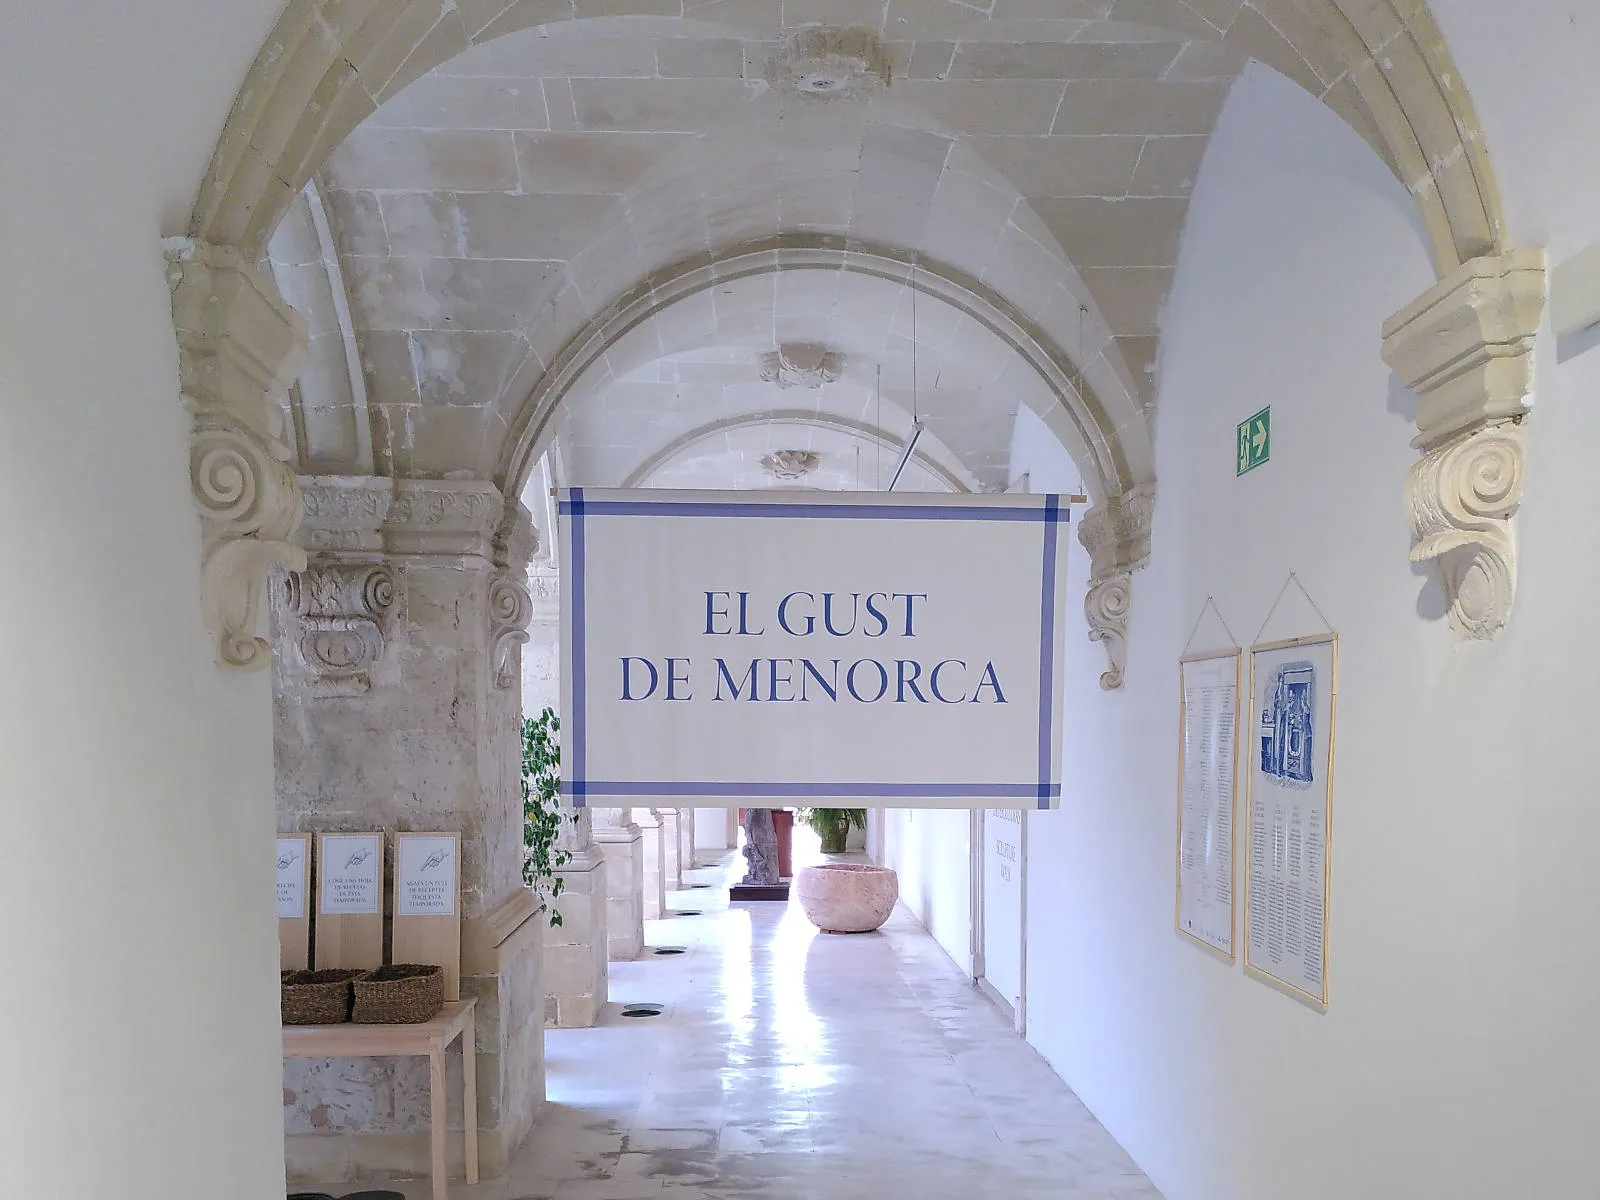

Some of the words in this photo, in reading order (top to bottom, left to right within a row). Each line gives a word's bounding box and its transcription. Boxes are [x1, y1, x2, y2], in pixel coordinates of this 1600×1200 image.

[702, 591, 765, 636] EL
[777, 591, 928, 637] GUST
[618, 657, 693, 701] DE
[711, 658, 1009, 704] MENORCA
